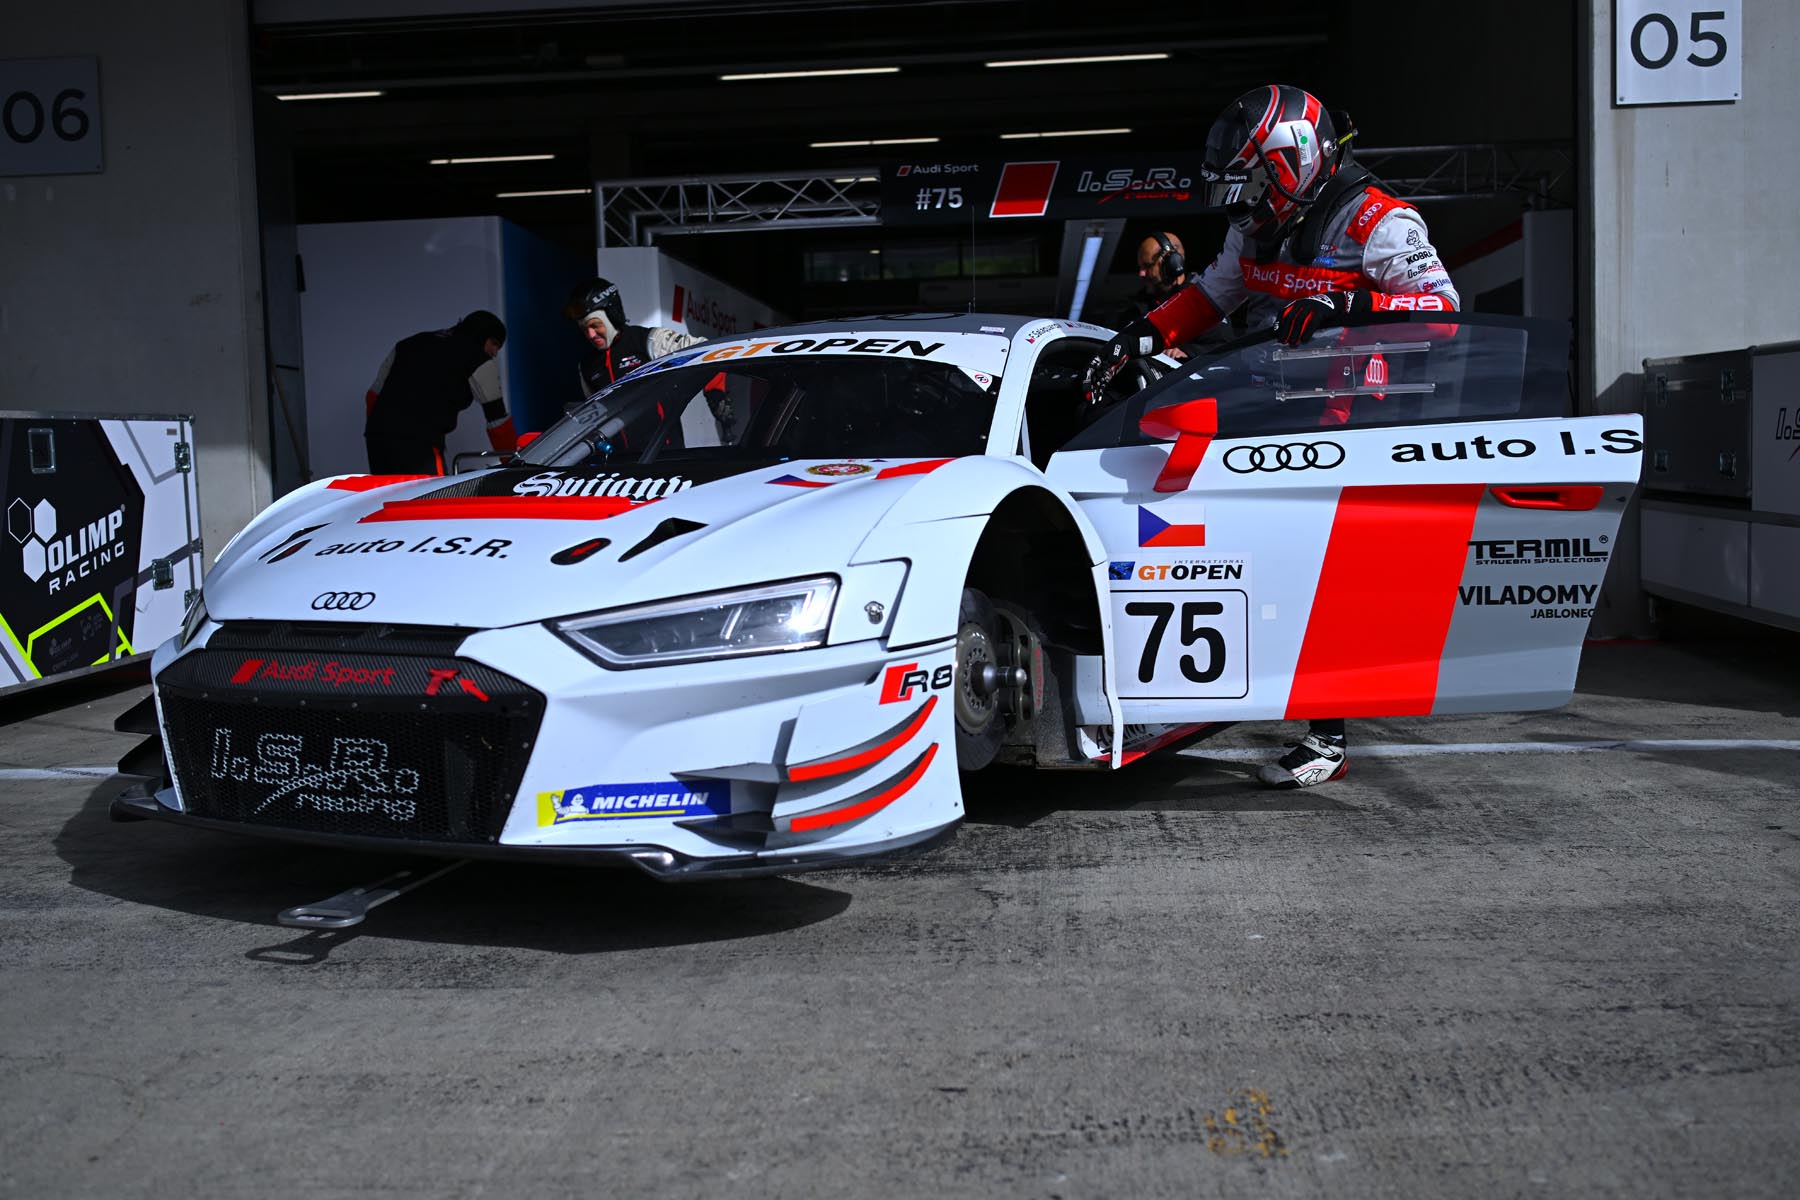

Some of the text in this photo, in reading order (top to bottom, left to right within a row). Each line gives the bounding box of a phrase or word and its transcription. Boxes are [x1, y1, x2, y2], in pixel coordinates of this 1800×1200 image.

[1630, 11, 1728, 70] 05
[3, 88, 89, 143] 06
[913, 163, 980, 175] Audi Sport
[915, 187, 963, 210] #75
[1283, 273, 1335, 293] Sport
[687, 289, 711, 325] Audi
[1391, 435, 1537, 463] auto
[47, 508, 123, 574] OLIMP
[314, 536, 513, 559] auto I.S.R.
[49, 541, 125, 595] RACING
[1458, 584, 1598, 606] VILADOMY
[1125, 601, 1227, 684] 75
[260, 660, 396, 687] Audi Sport
[899, 664, 953, 697] R8
[592, 791, 709, 811] MICHELIN
